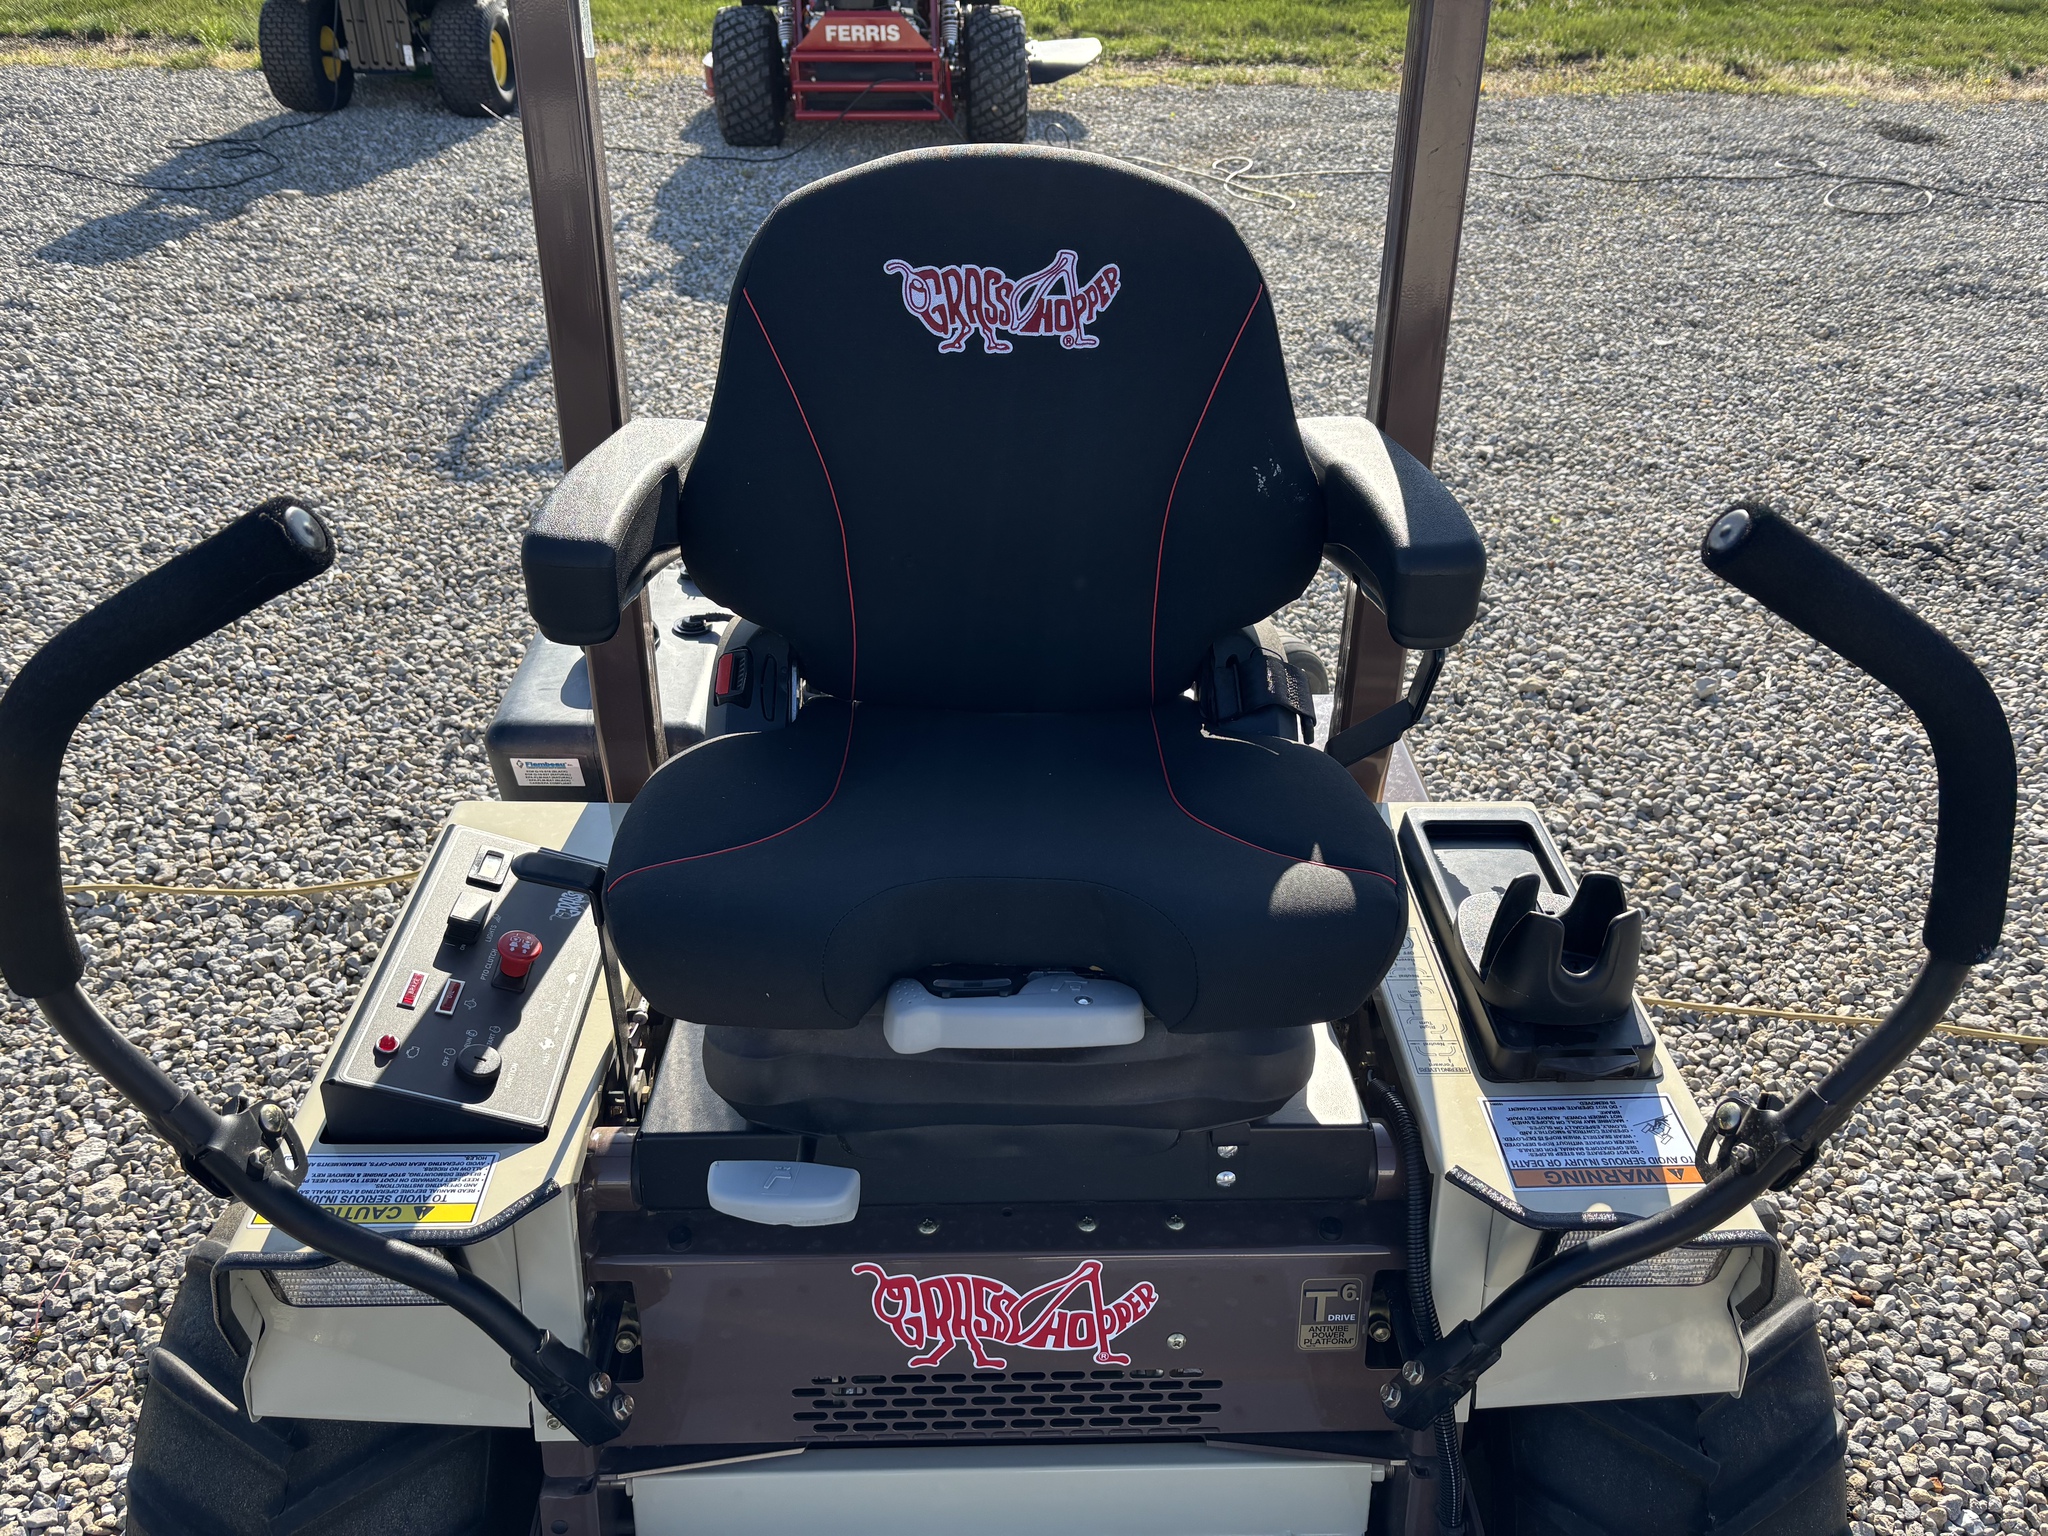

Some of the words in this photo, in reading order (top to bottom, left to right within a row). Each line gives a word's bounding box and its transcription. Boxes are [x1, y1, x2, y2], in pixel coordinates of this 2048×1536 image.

[824, 24, 901, 42] FERRIS
[485, 924, 497, 943] LIGHTS
[459, 943, 466, 951] ON
[480, 969, 489, 981] PTO
[485, 948, 498, 970] CLUTCH
[554, 998, 569, 1026] THROTTLE
[486, 1033, 496, 1046] TART
[442, 1055, 450, 1067] OFF
[504, 1062, 519, 1089] IGNITION
[1511, 1160, 1545, 1168] DEATH
[1545, 1159, 1561, 1167] OR
[1564, 1158, 1599, 1167] INJURY
[1601, 1157, 1645, 1165] SERIOUS
[1648, 1156, 1677, 1164] AVOID
[1543, 1168, 1660, 1184] WARNING
[340, 1195, 392, 1203] SERIOUS
[324, 1207, 402, 1219] CAUTI
[1328, 1314, 1356, 1322] DRIVE
[1308, 1325, 1349, 1333] ANTIVIBE
